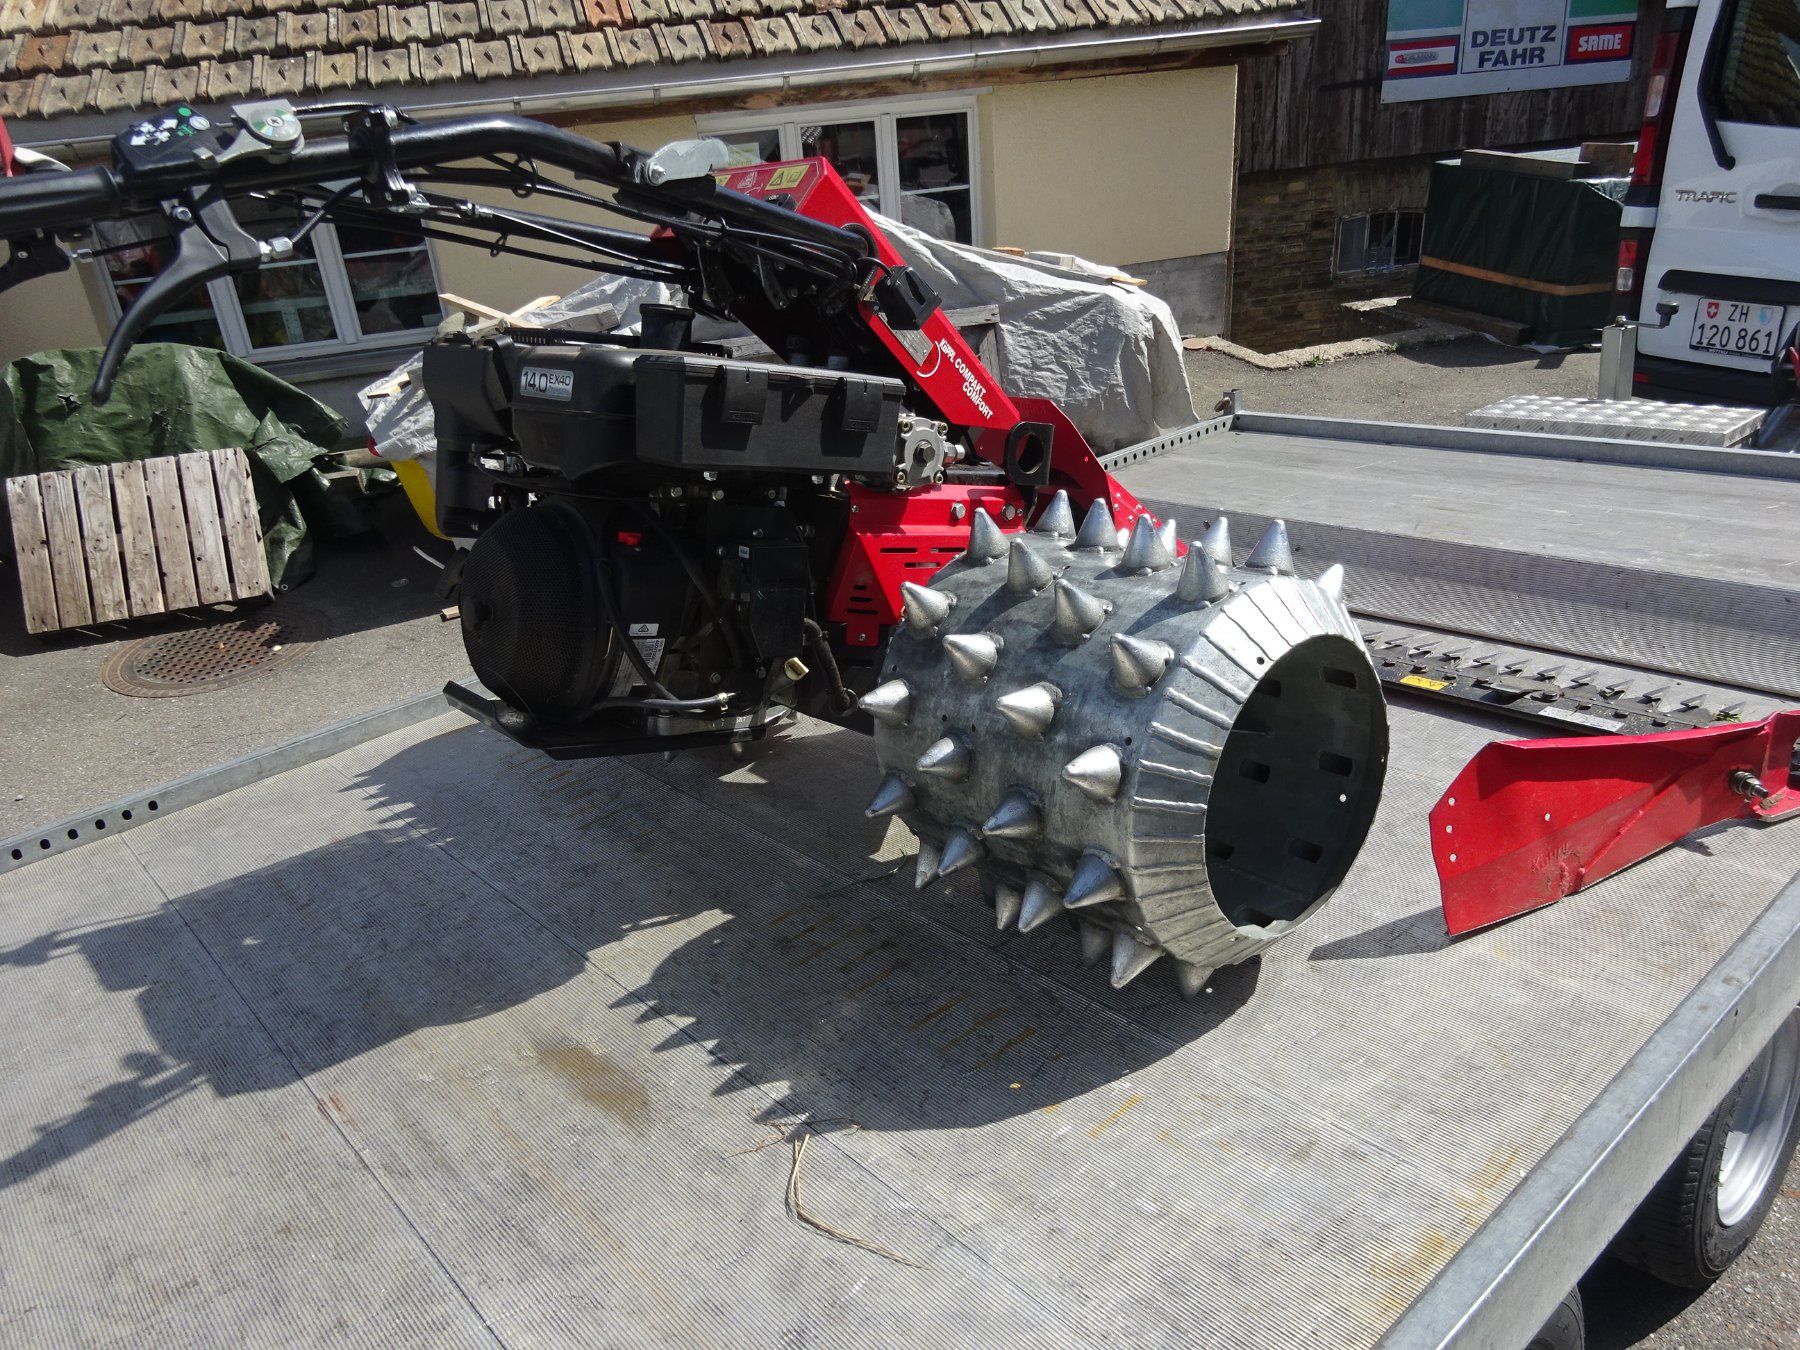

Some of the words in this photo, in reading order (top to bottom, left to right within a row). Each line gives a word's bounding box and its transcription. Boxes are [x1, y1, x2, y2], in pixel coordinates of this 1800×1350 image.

[1471, 25, 1557, 48] DEUTZ
[1578, 33, 1623, 52] SAME
[1478, 47, 1545, 68] FAHR
[1675, 189, 1737, 204] TRAFIC
[1727, 304, 1750, 323] ZH
[1696, 323, 1731, 348] 120
[1735, 328, 1773, 354] 861
[523, 371, 548, 393] 14.0
[549, 374, 571, 386] EX40
[954, 358, 987, 398] COMPAKT
[962, 382, 993, 420] COMFORT
